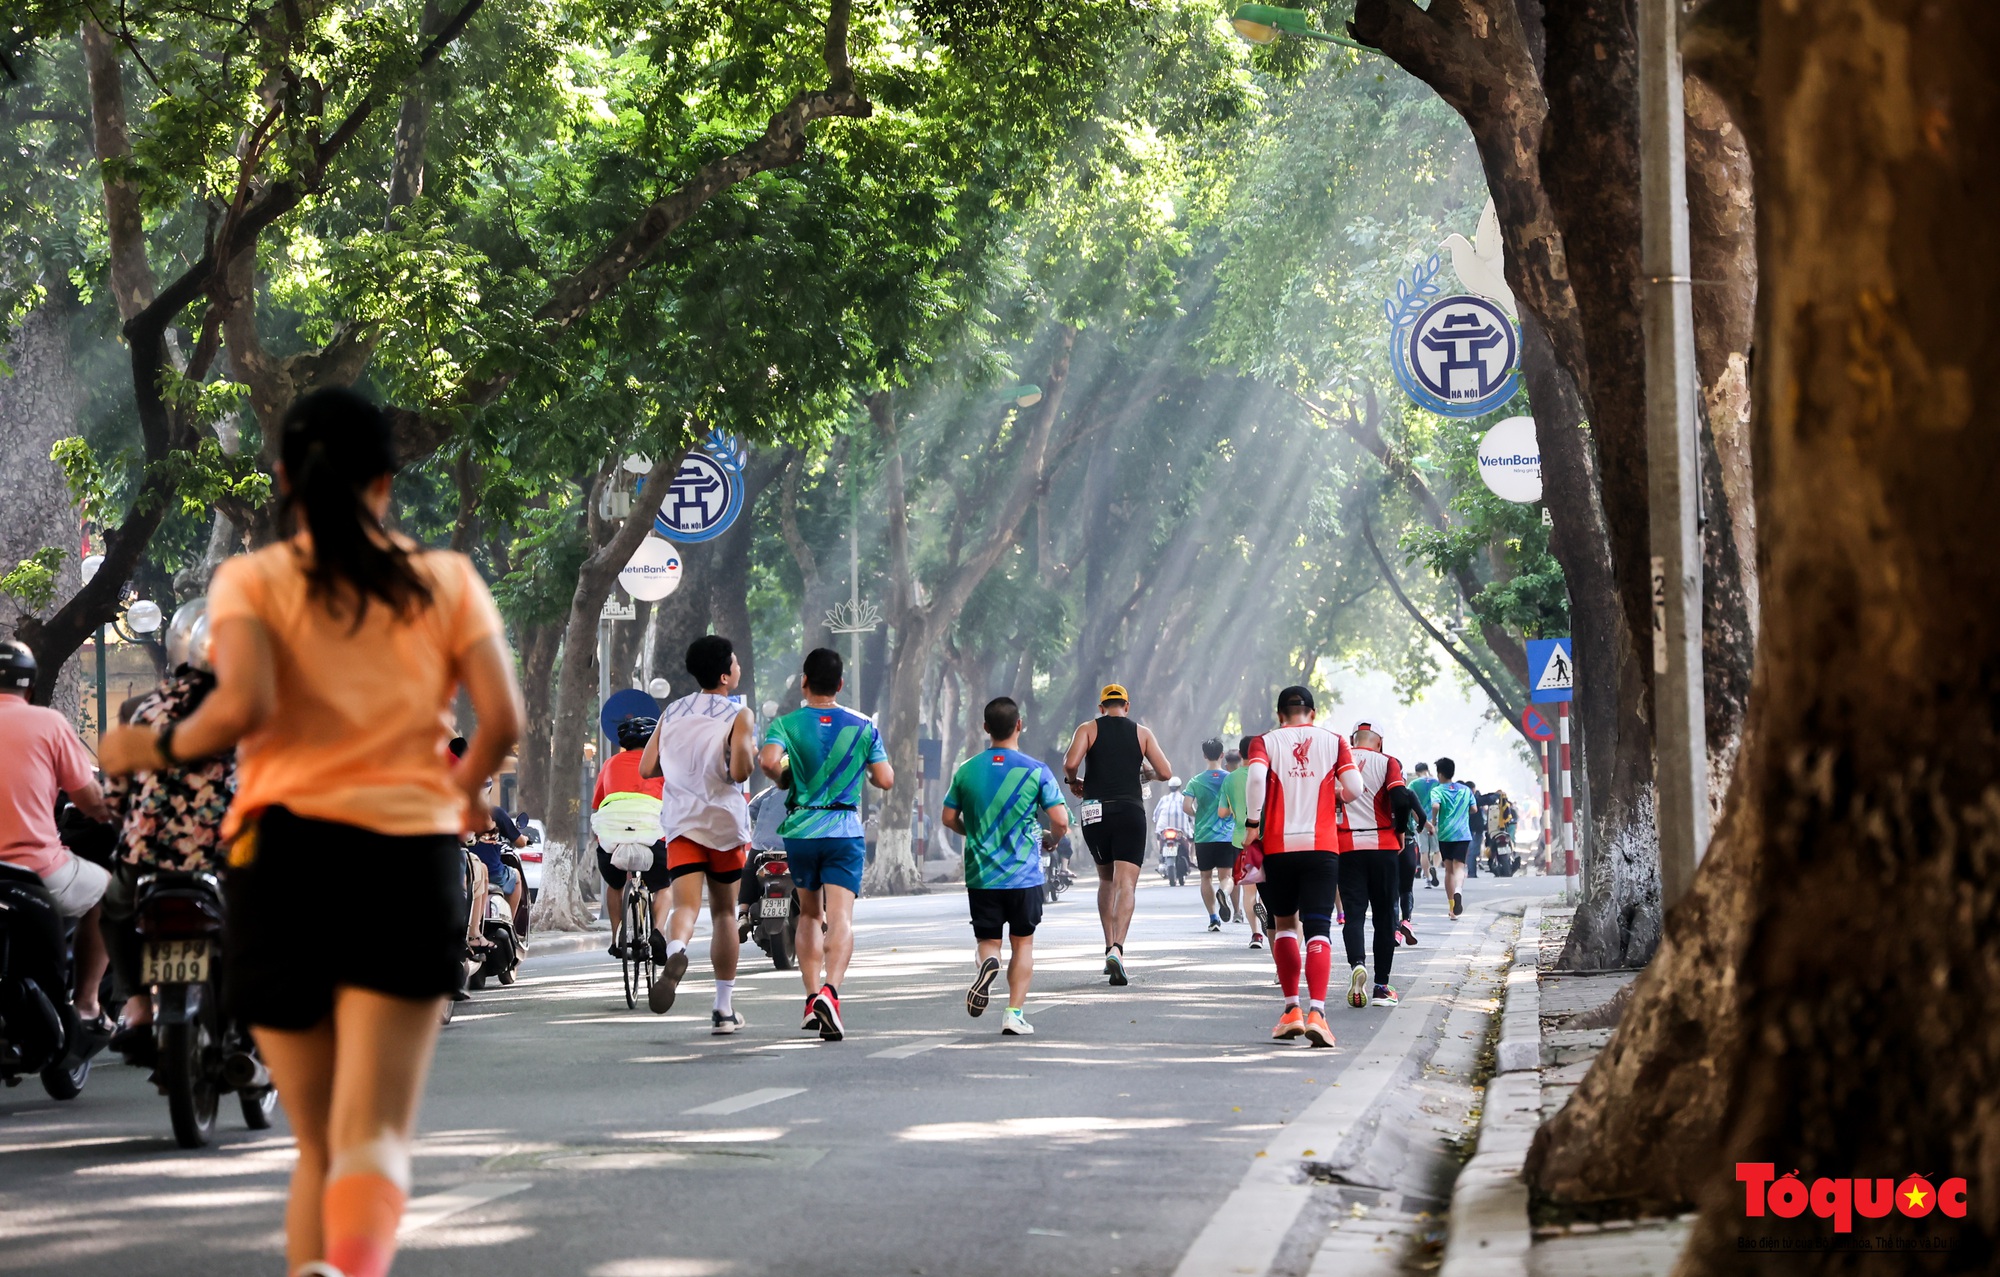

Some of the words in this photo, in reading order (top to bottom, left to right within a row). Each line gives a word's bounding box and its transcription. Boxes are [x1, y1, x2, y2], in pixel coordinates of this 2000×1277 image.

[1451, 389, 1462, 399] HÀ
[1464, 388, 1478, 400] NỘI
[623, 565, 666, 573] ietinBank
[150, 961, 200, 982] 5009
